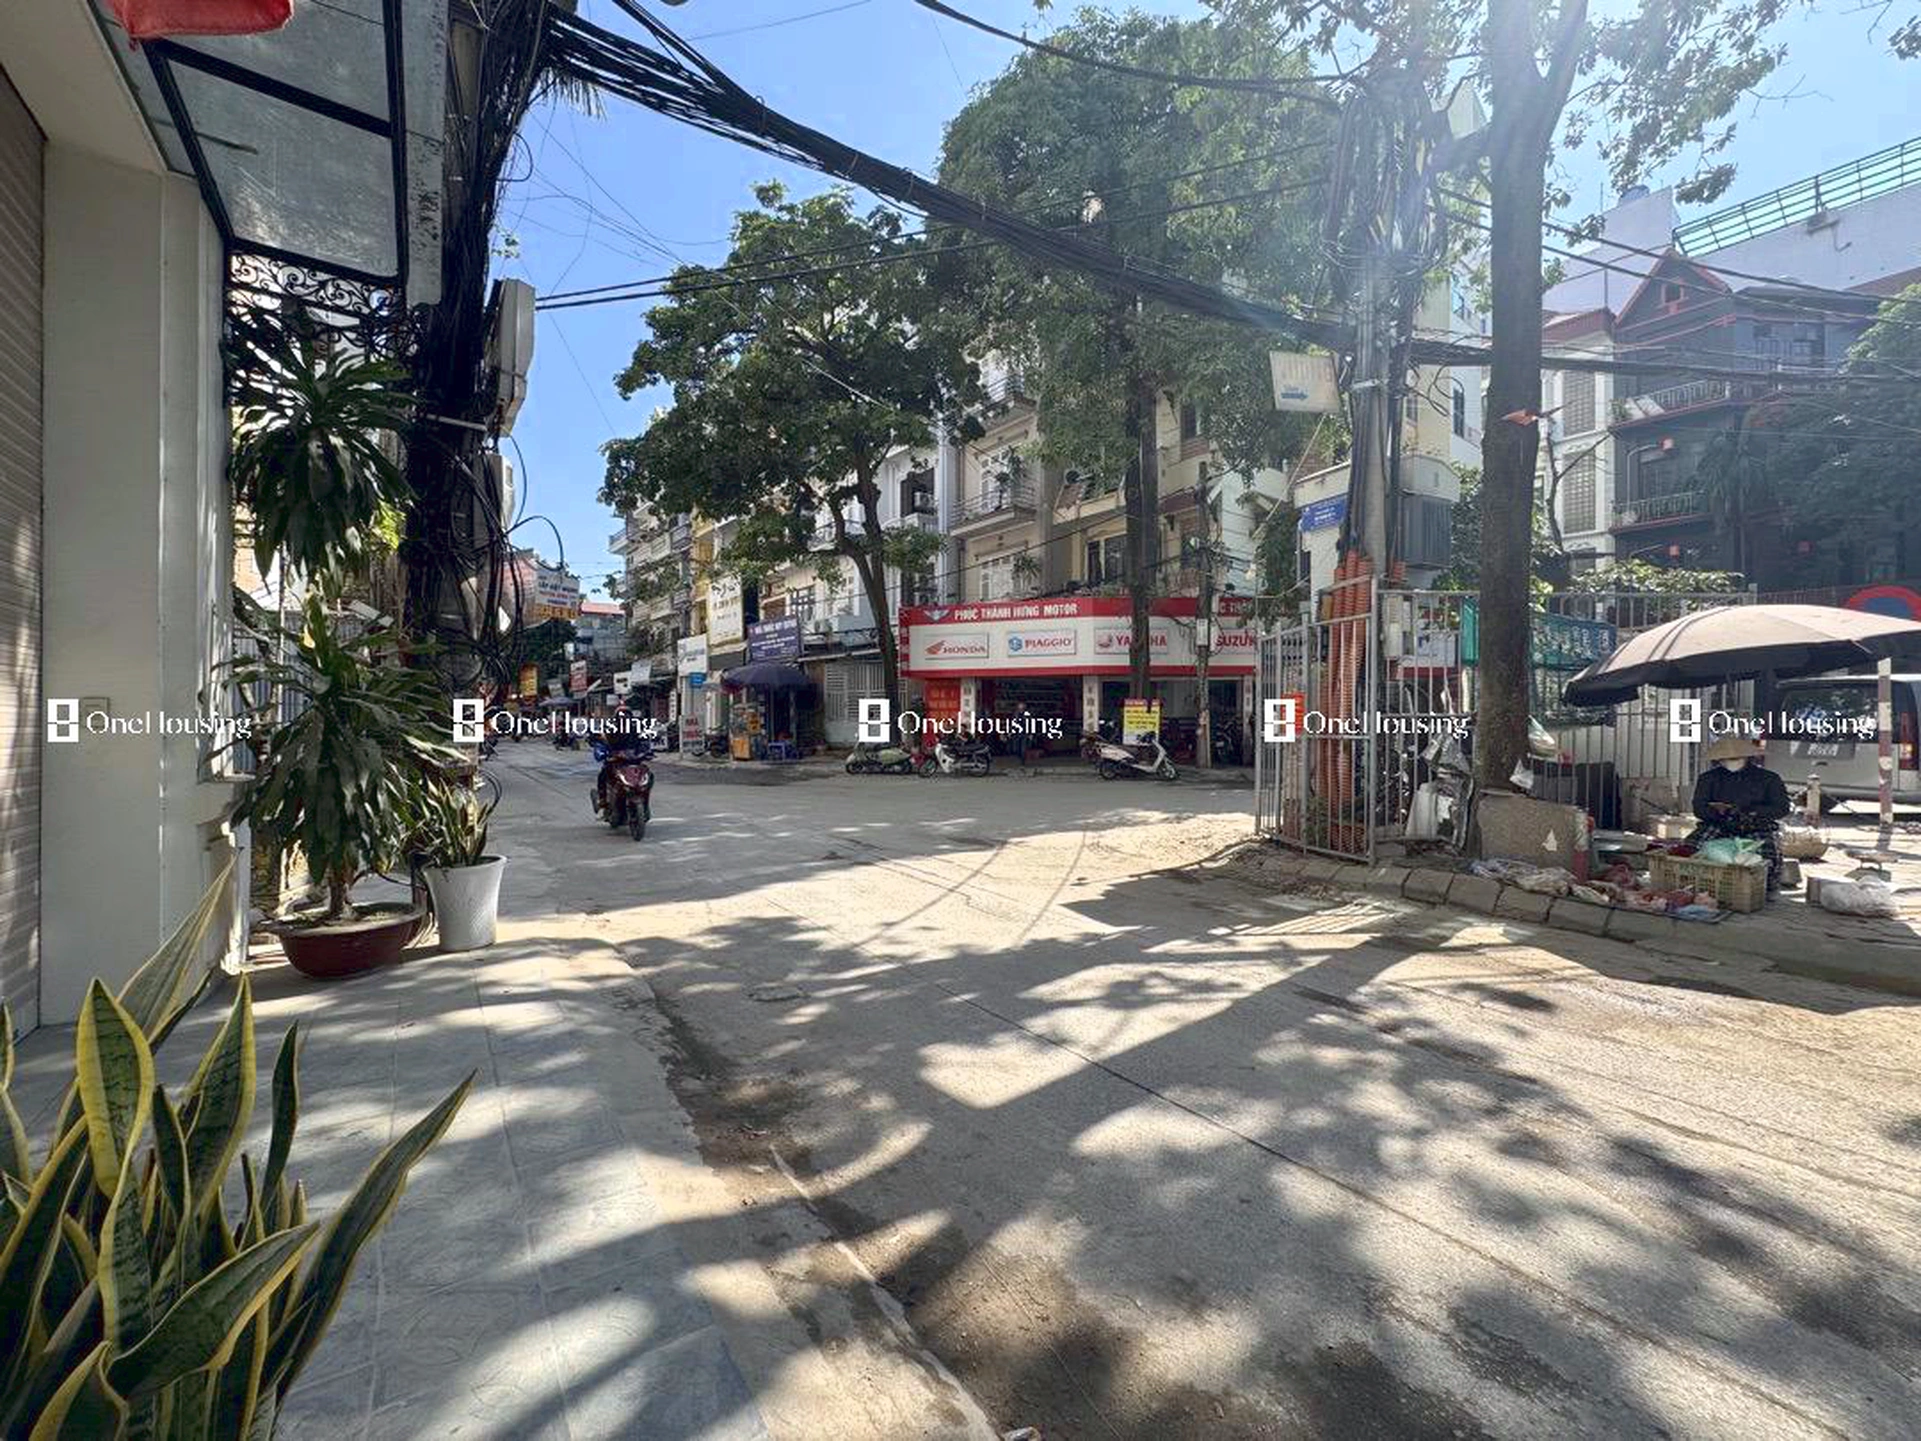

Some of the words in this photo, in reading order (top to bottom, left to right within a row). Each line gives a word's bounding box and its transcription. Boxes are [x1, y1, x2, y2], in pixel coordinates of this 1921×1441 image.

[1043, 603, 1077, 615] MOTOR
[1025, 637, 1071, 648] PIAGGIO
[1116, 635, 1167, 645] YAHA
[943, 646, 986, 655] HONDA
